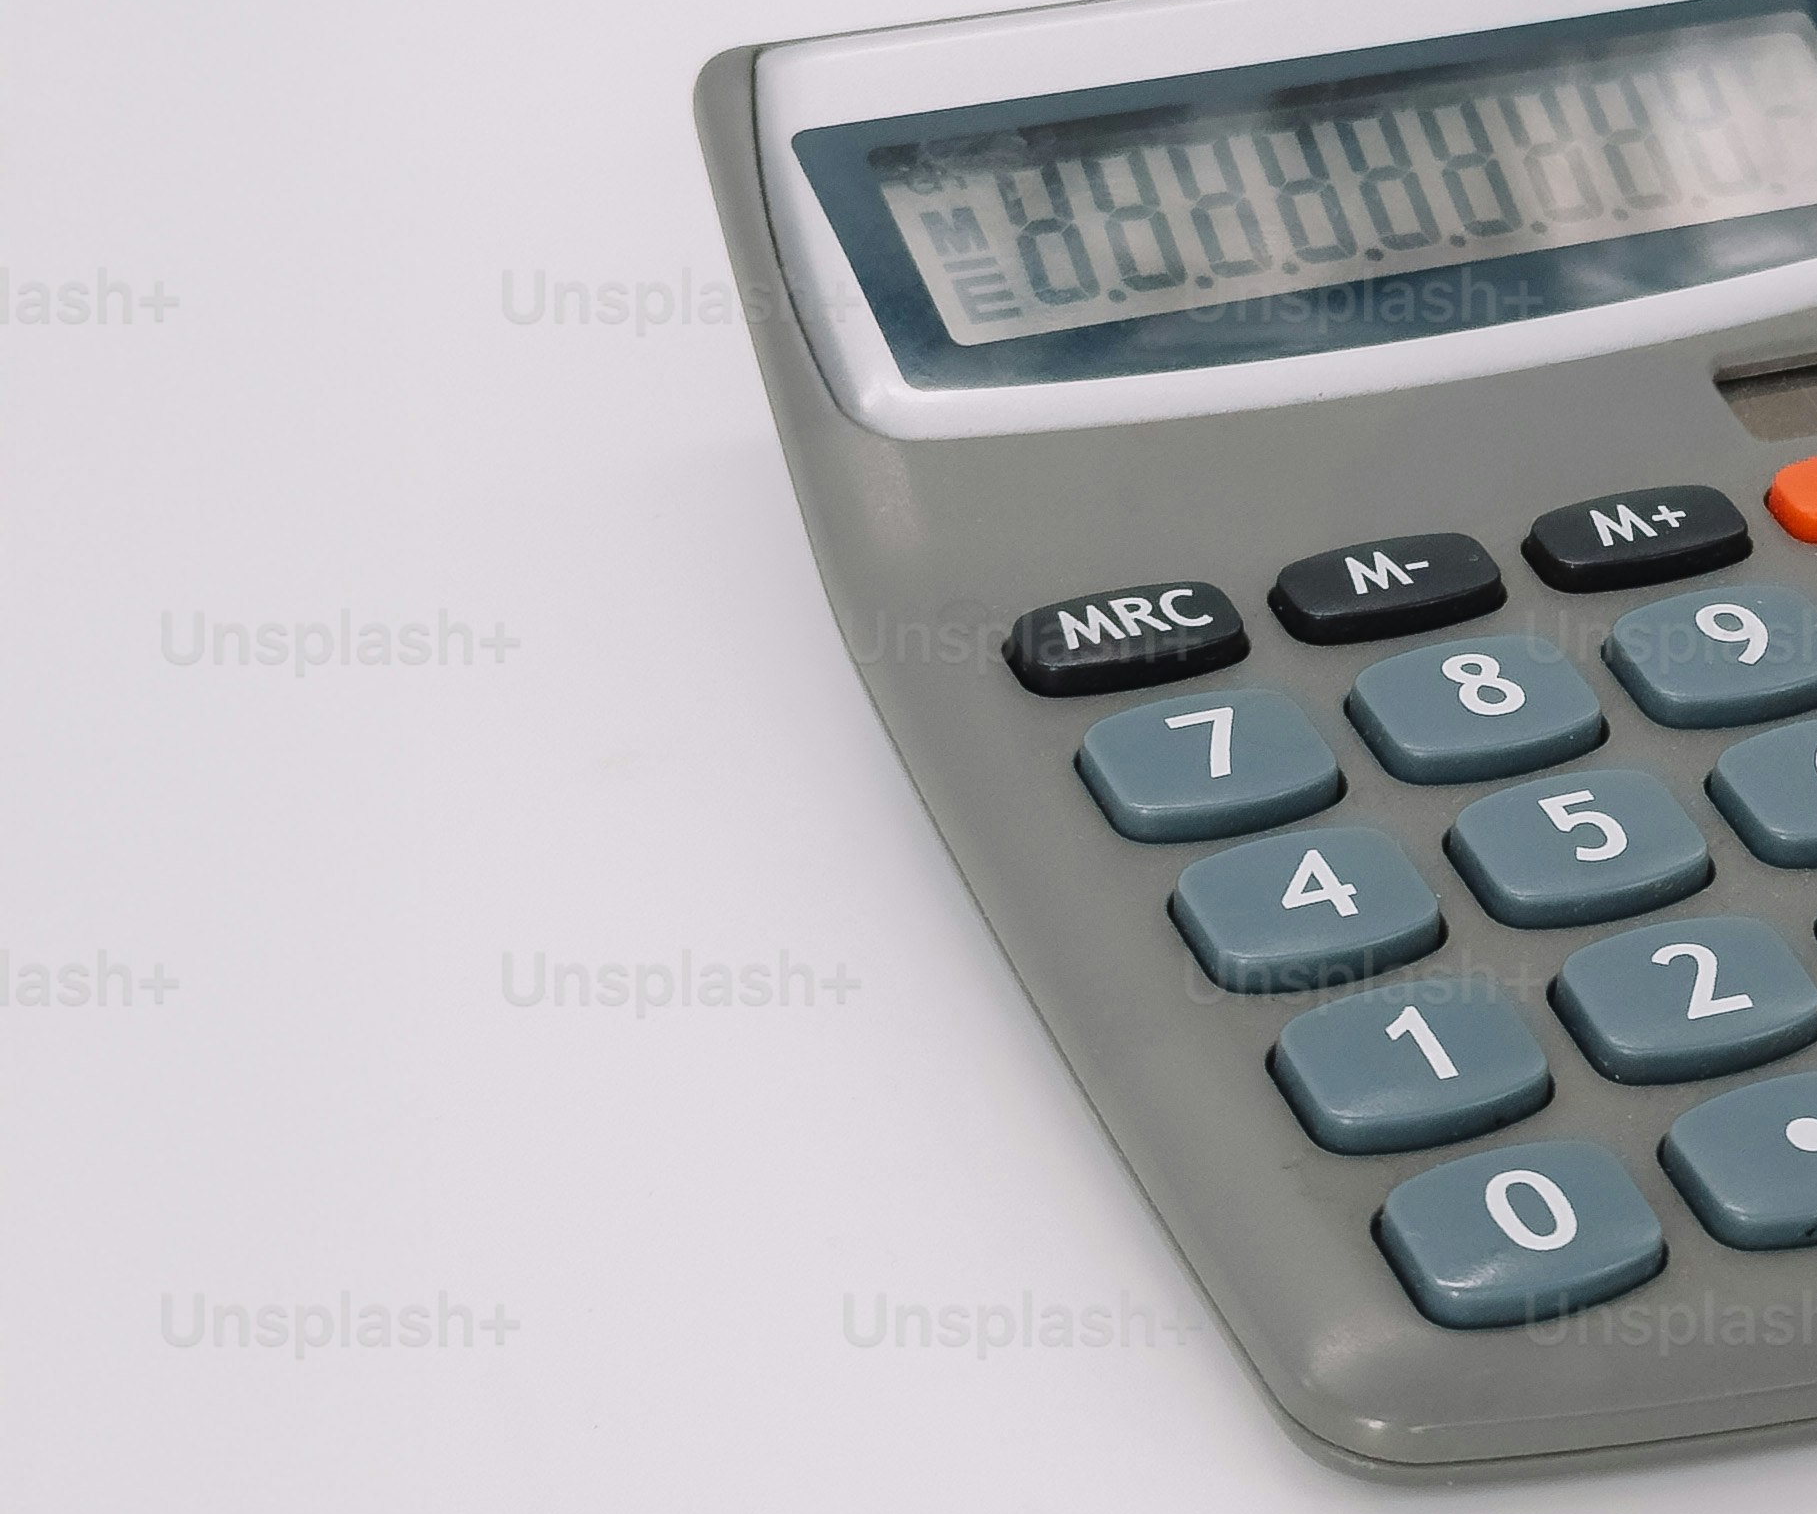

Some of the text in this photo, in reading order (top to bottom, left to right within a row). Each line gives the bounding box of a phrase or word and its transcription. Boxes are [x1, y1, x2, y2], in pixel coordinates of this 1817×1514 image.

[1589, 504, 1687, 547] M+
[1057, 588, 1214, 650] MRC
[1695, 603, 1769, 665] 9
[1441, 653, 1526, 716] 8
[1164, 706, 1234, 779] 7
[1537, 789, 1628, 862] 5
[1281, 849, 1359, 917] 4
[1651, 943, 1754, 1020] 2
[1385, 1005, 1459, 1080] 1
[1485, 1169, 1578, 1251] 0
